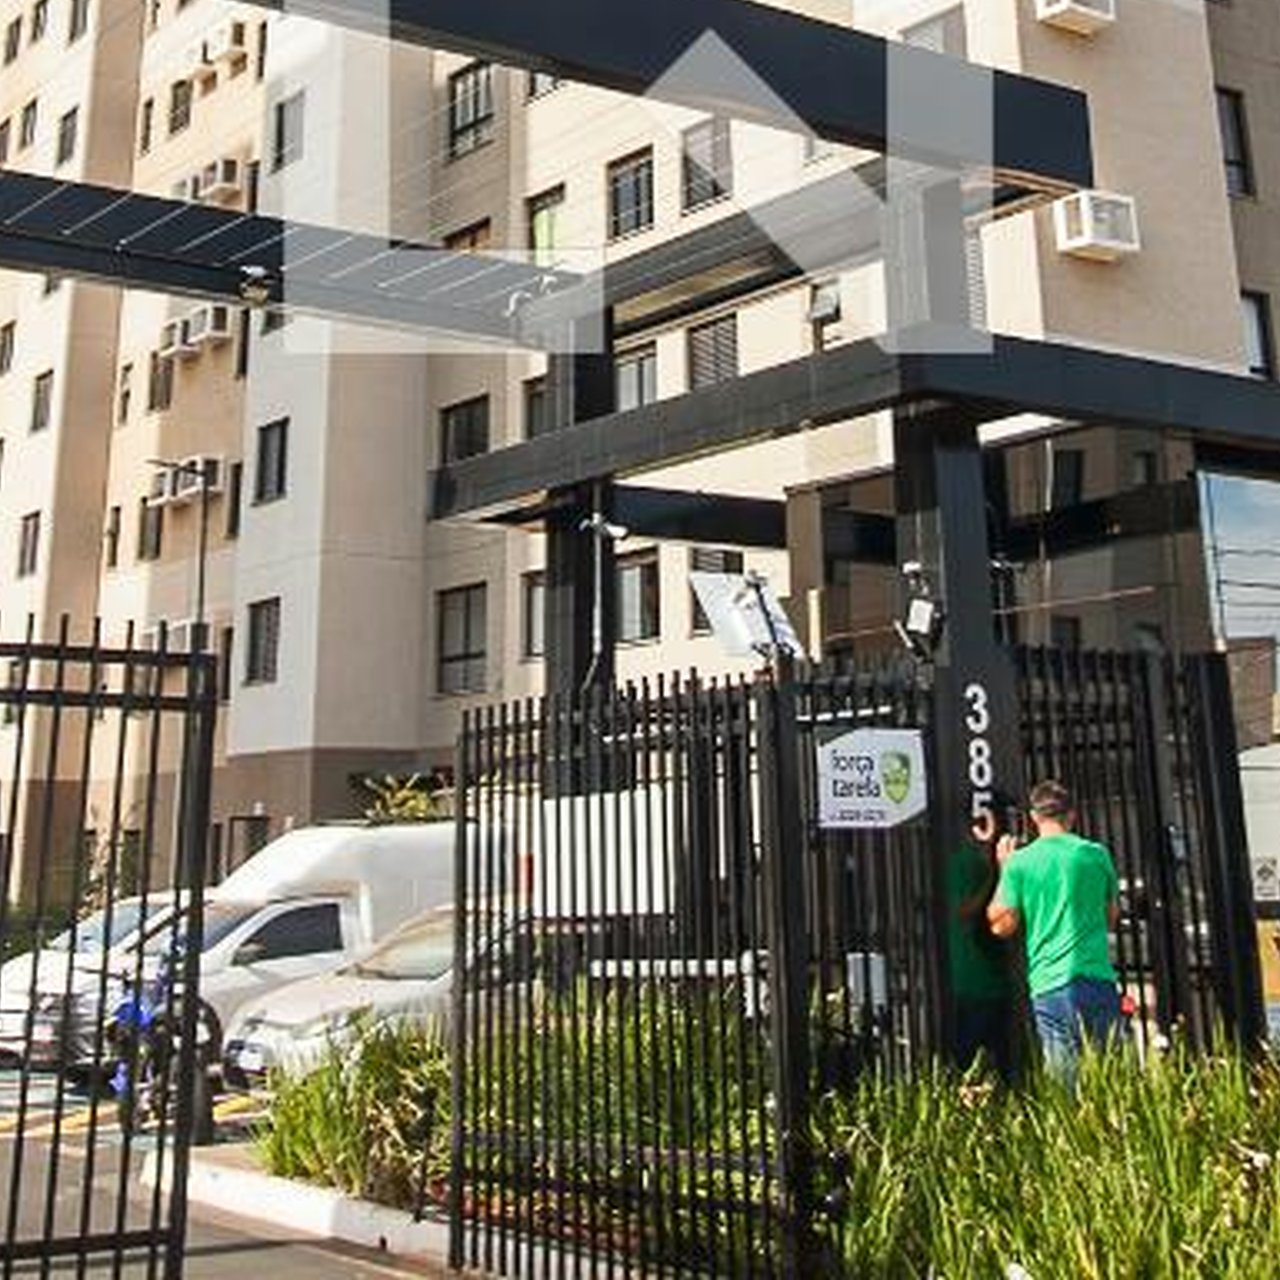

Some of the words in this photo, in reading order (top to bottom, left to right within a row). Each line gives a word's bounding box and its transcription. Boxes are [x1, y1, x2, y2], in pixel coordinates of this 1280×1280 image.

[831, 749, 875, 776] força
[965, 683, 995, 841] 385
[831, 776, 881, 798] tarefa
